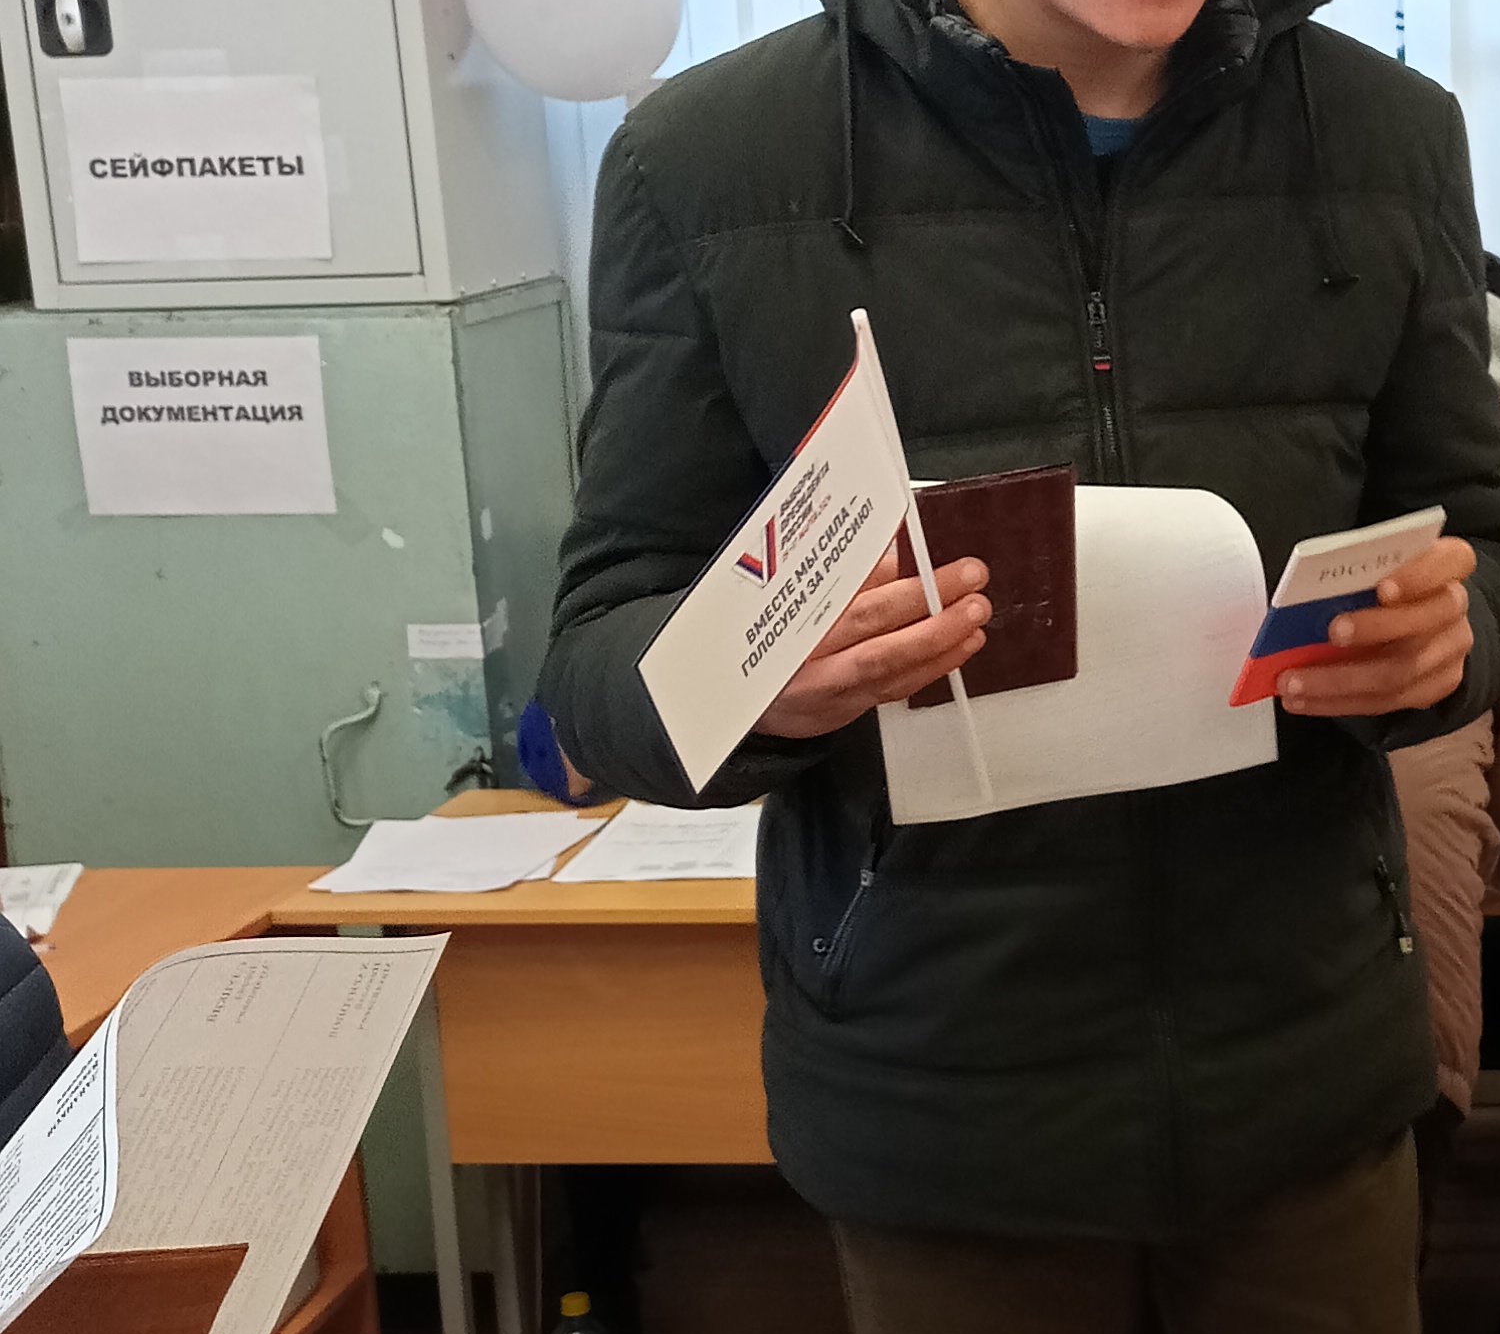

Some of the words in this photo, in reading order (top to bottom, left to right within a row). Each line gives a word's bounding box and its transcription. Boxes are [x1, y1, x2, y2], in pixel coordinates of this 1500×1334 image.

[88, 152, 305, 179] СЕЙФПАКЕТЫ
[128, 370, 268, 388] ВЫБОРНАЯ
[101, 405, 303, 425] ДОКУМЕНТАЦИЯ
[741, 590, 808, 677] ГОЛОСУЕМ
[807, 570, 824, 595] ЗА
[823, 498, 874, 573] РОССИЮ!
[745, 578, 796, 645] ВМЕСТЕ
[794, 548, 818, 583] МЫ
[818, 506, 850, 552] СИЛА
